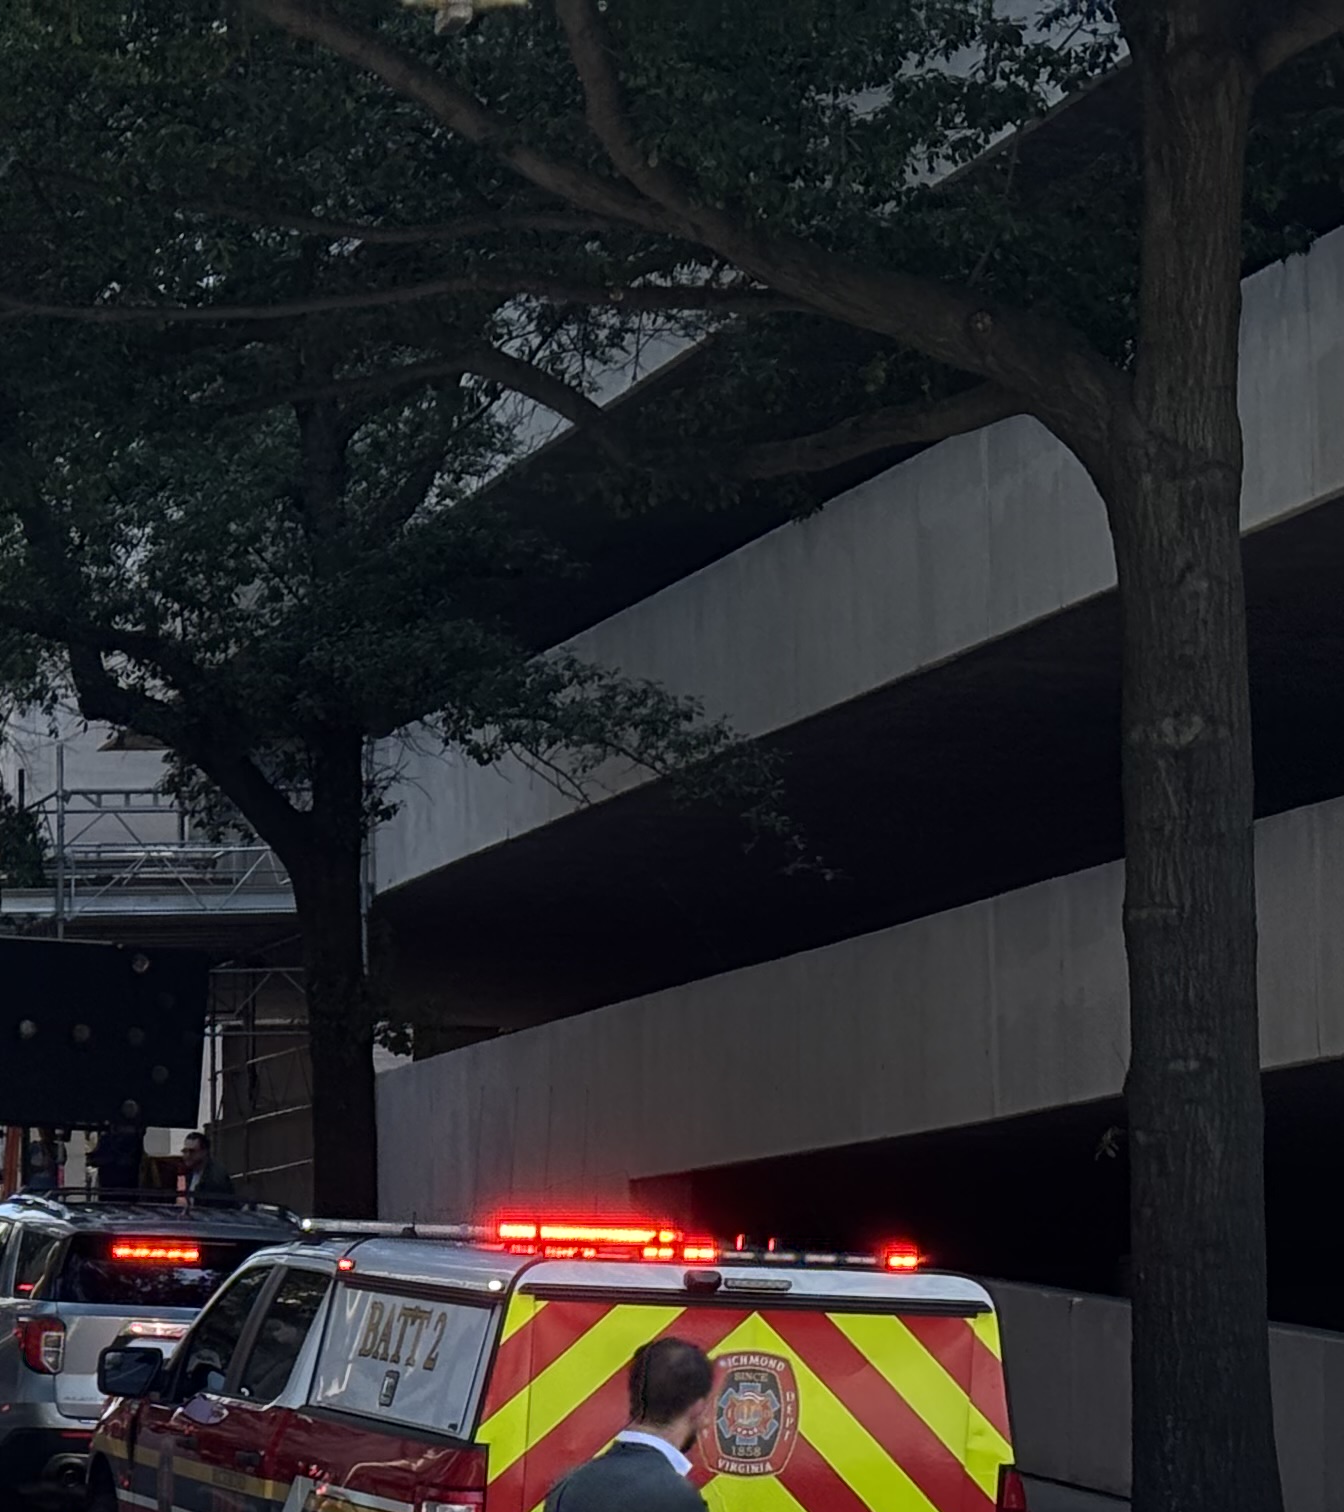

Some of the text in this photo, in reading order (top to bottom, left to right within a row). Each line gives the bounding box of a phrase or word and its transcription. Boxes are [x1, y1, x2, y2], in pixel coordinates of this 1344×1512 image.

[358, 1301, 448, 1371] BATT 2
[733, 1372, 769, 1382] SINCE
[732, 1446, 762, 1457] 1858
[717, 1459, 774, 1474] VIRGINIA
